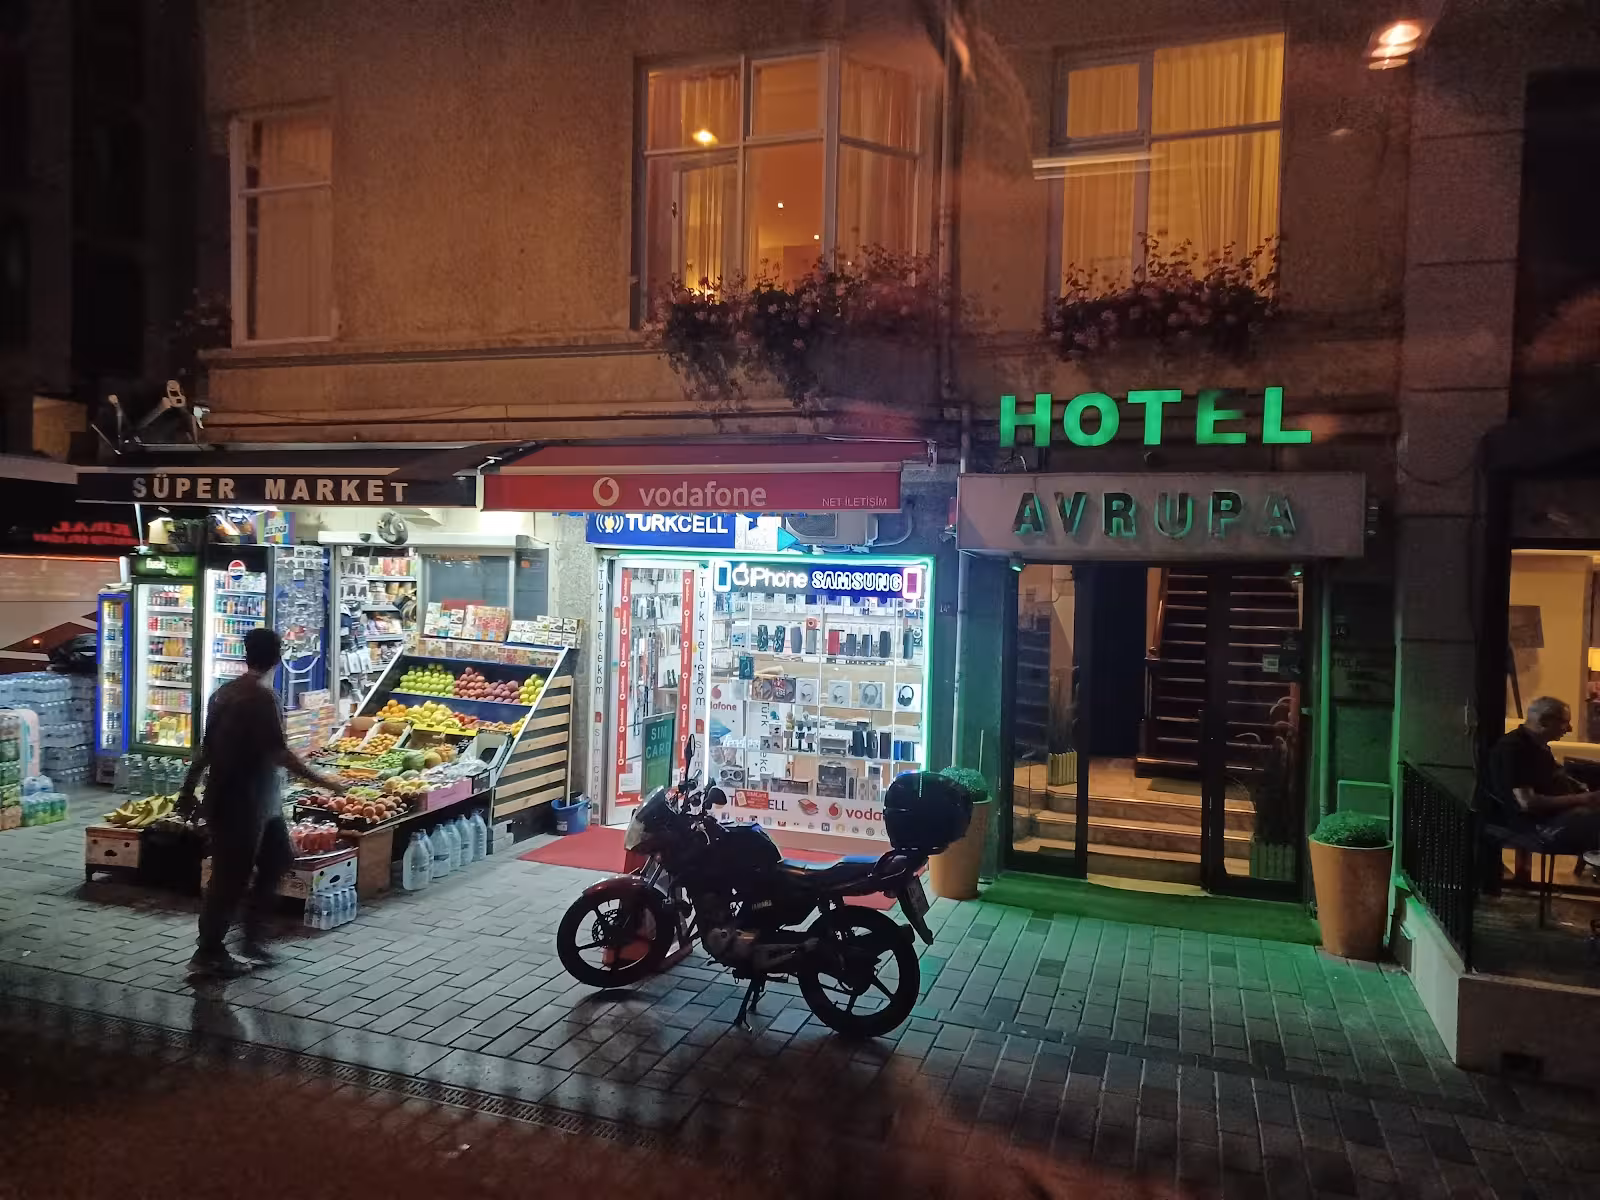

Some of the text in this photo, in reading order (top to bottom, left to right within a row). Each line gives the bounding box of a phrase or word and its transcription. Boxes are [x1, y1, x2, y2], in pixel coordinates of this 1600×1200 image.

[999, 386, 1313, 448] HOTEL
[132, 473, 409, 504] SÜPER MARKET
[639, 480, 768, 508] vodafone
[822, 495, 888, 508] NET İLETİŞİM
[625, 513, 729, 534] TURKCELL
[1011, 490, 1296, 540] AVRUPA
[811, 570, 904, 592] SAMSUNG
[651, 725, 668, 741] SIM
[645, 742, 671, 759] CARD
